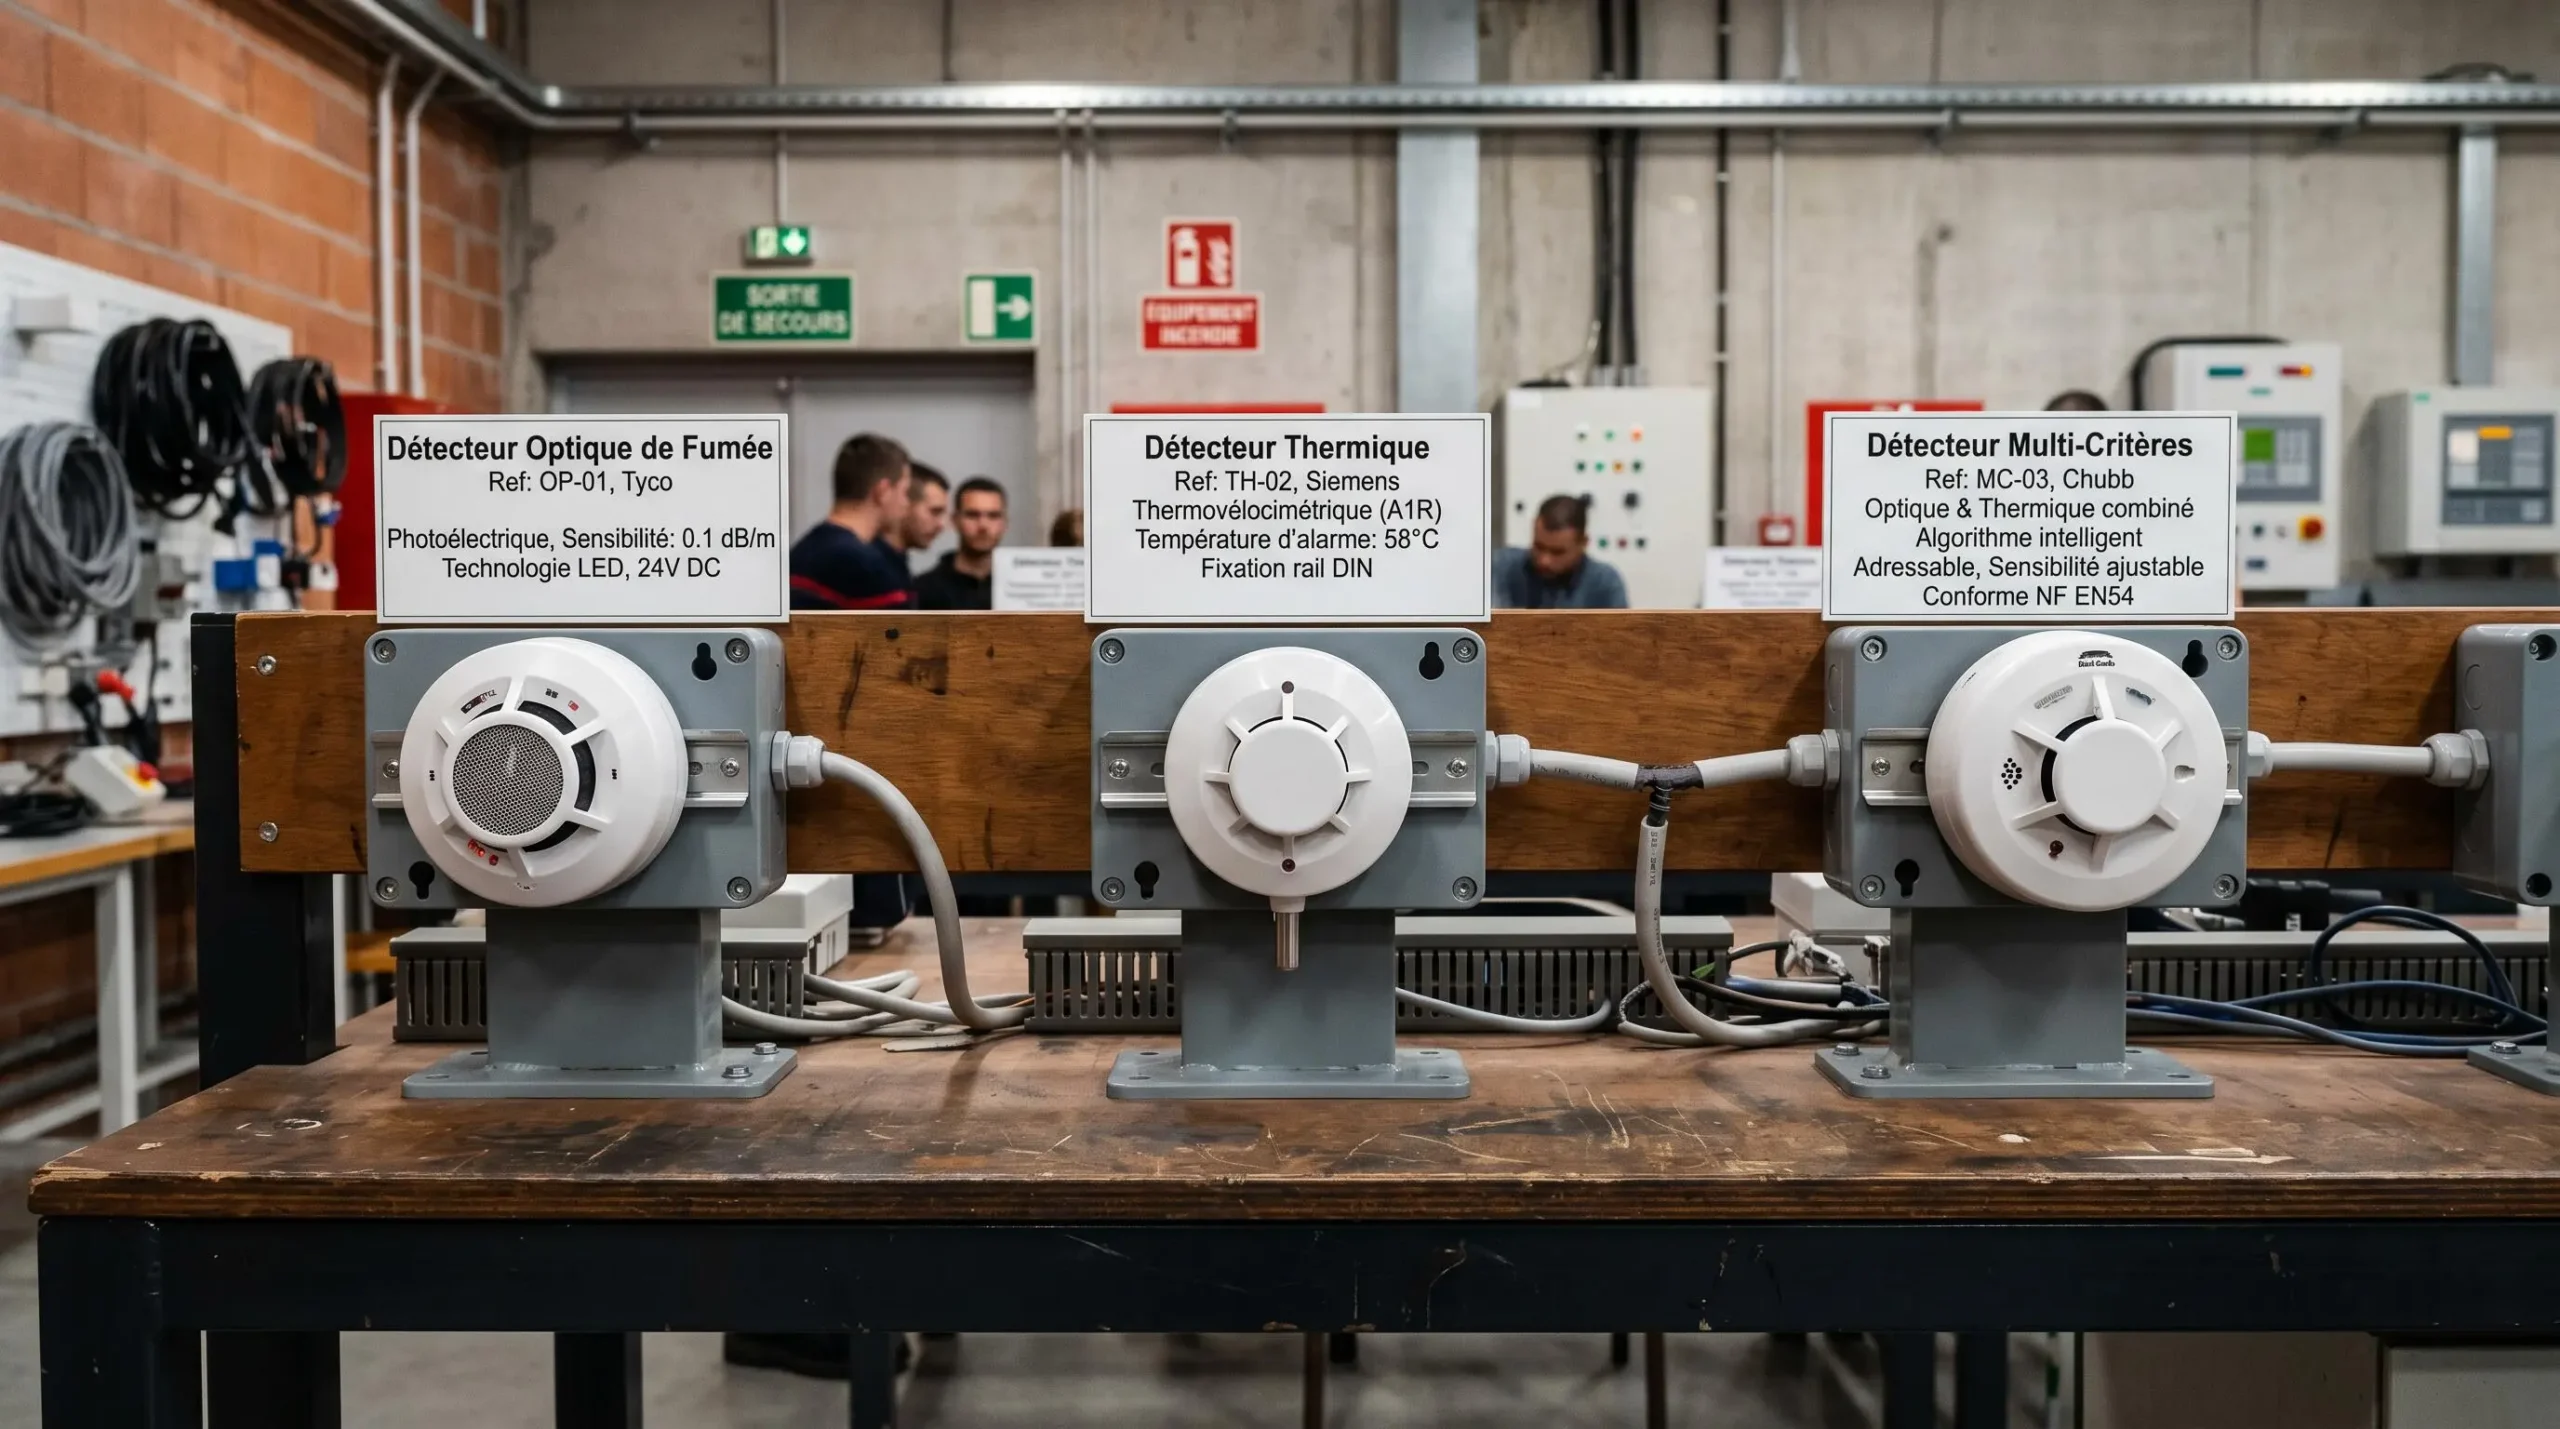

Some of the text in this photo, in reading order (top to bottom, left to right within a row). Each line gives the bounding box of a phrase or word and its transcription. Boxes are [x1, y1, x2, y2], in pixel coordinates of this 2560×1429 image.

[746, 283, 821, 308] SORTIE
[719, 310, 848, 335] DE SECOURS
[387, 433, 773, 467] Détecteur Optique de Fumée
[1145, 433, 1430, 466] Détecteur Thermique
[1867, 431, 2193, 458] Détecteur Multi-Critères
[489, 470, 673, 498] Ref: OP-01, Tyco
[1175, 469, 1400, 495] Ref: TH-02, Siemens
[1925, 468, 2135, 493] Ref: MC-03, Chubb
[1132, 498, 1442, 526] Thermovélocimétrique (A1R)
[1864, 496, 2195, 524] Optique & Thermique combiné
[387, 526, 775, 555] Photoélectrique, Sensibilité: 0.1 dB/m
[1134, 527, 1439, 555] Température d'alarme: 58°C
[1915, 526, 2143, 554] Algorithme intelligent
[441, 556, 721, 584] Technologie LED, 24V DC
[1202, 557, 1373, 579] Fixation rail DIN
[1852, 555, 2205, 583] Adressable, Sensibilité ajustable
[1922, 585, 2135, 607] Conforme NF EN54
